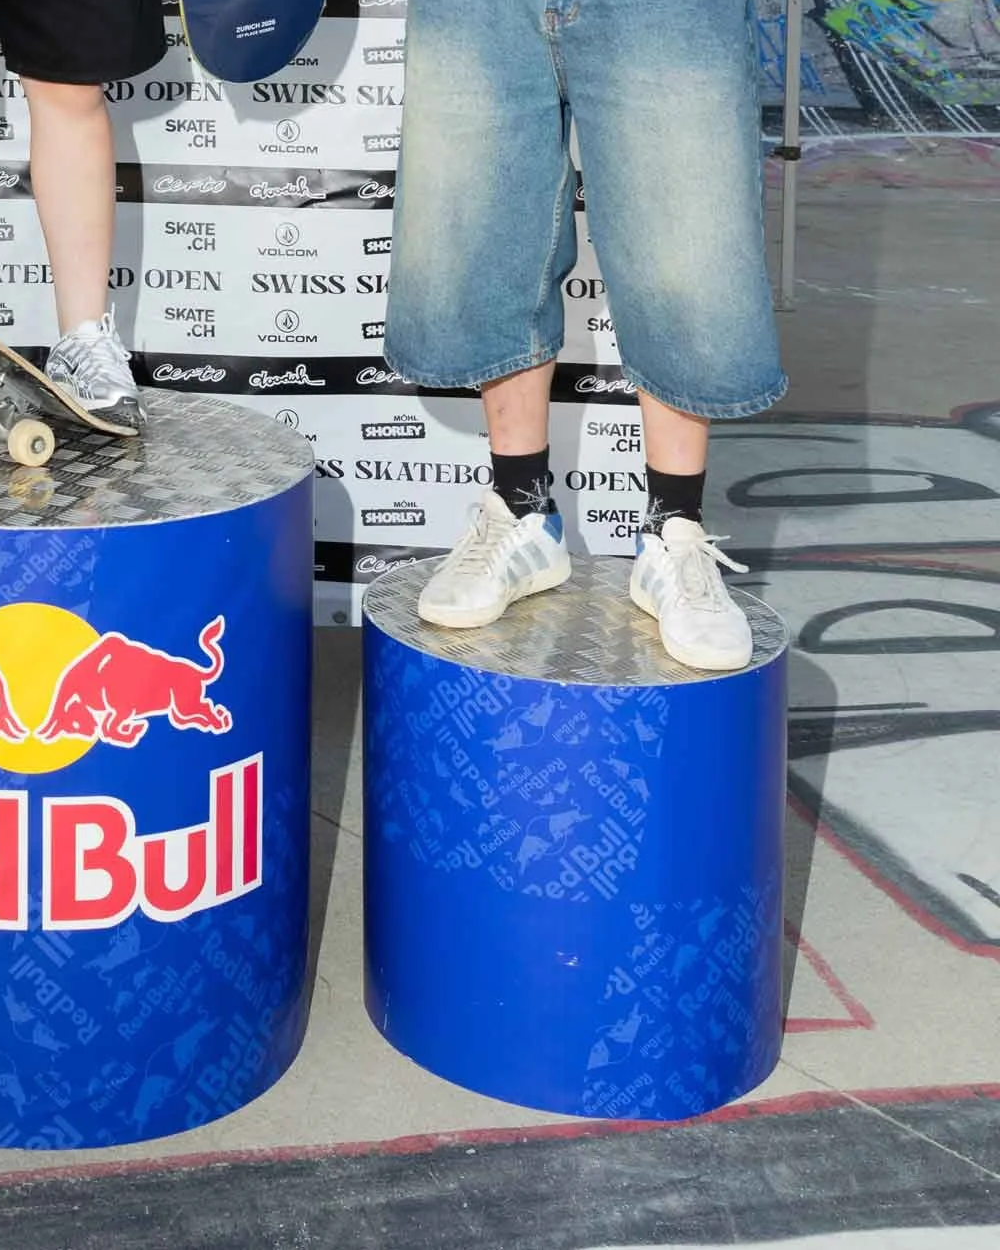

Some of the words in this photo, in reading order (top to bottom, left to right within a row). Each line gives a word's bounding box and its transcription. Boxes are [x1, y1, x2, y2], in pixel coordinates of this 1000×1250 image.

[145, 81, 223, 102] OPEN
[252, 83, 345, 105] SWISS
[165, 120, 216, 133] SKATE
[187, 135, 216, 148] .CH
[258, 144, 318, 154] VOLCOM
[153, 175, 227, 193] Certo
[165, 222, 216, 235] SKATE
[187, 237, 216, 251] .CH
[258, 248, 318, 258] VOLCOM
[144, 269, 223, 291] OPEN
[252, 273, 345, 295] SWISS
[165, 308, 215, 322] SKATE
[187, 324, 215, 337] .CH
[258, 334, 318, 343] VOLCOM
[153, 364, 227, 382] Certo
[249, 364, 326, 387] doodah
[365, 424, 424, 438] SHORLEY
[586, 422, 640, 437] SKATE
[610, 439, 640, 452] .CH
[355, 459, 495, 486] SKATEBO
[565, 469, 648, 493] OPEN
[365, 511, 424, 524] SHORLEY
[586, 510, 640, 523] SKATE
[609, 525, 640, 538] .CH
[42, 751, 263, 931] Bull
